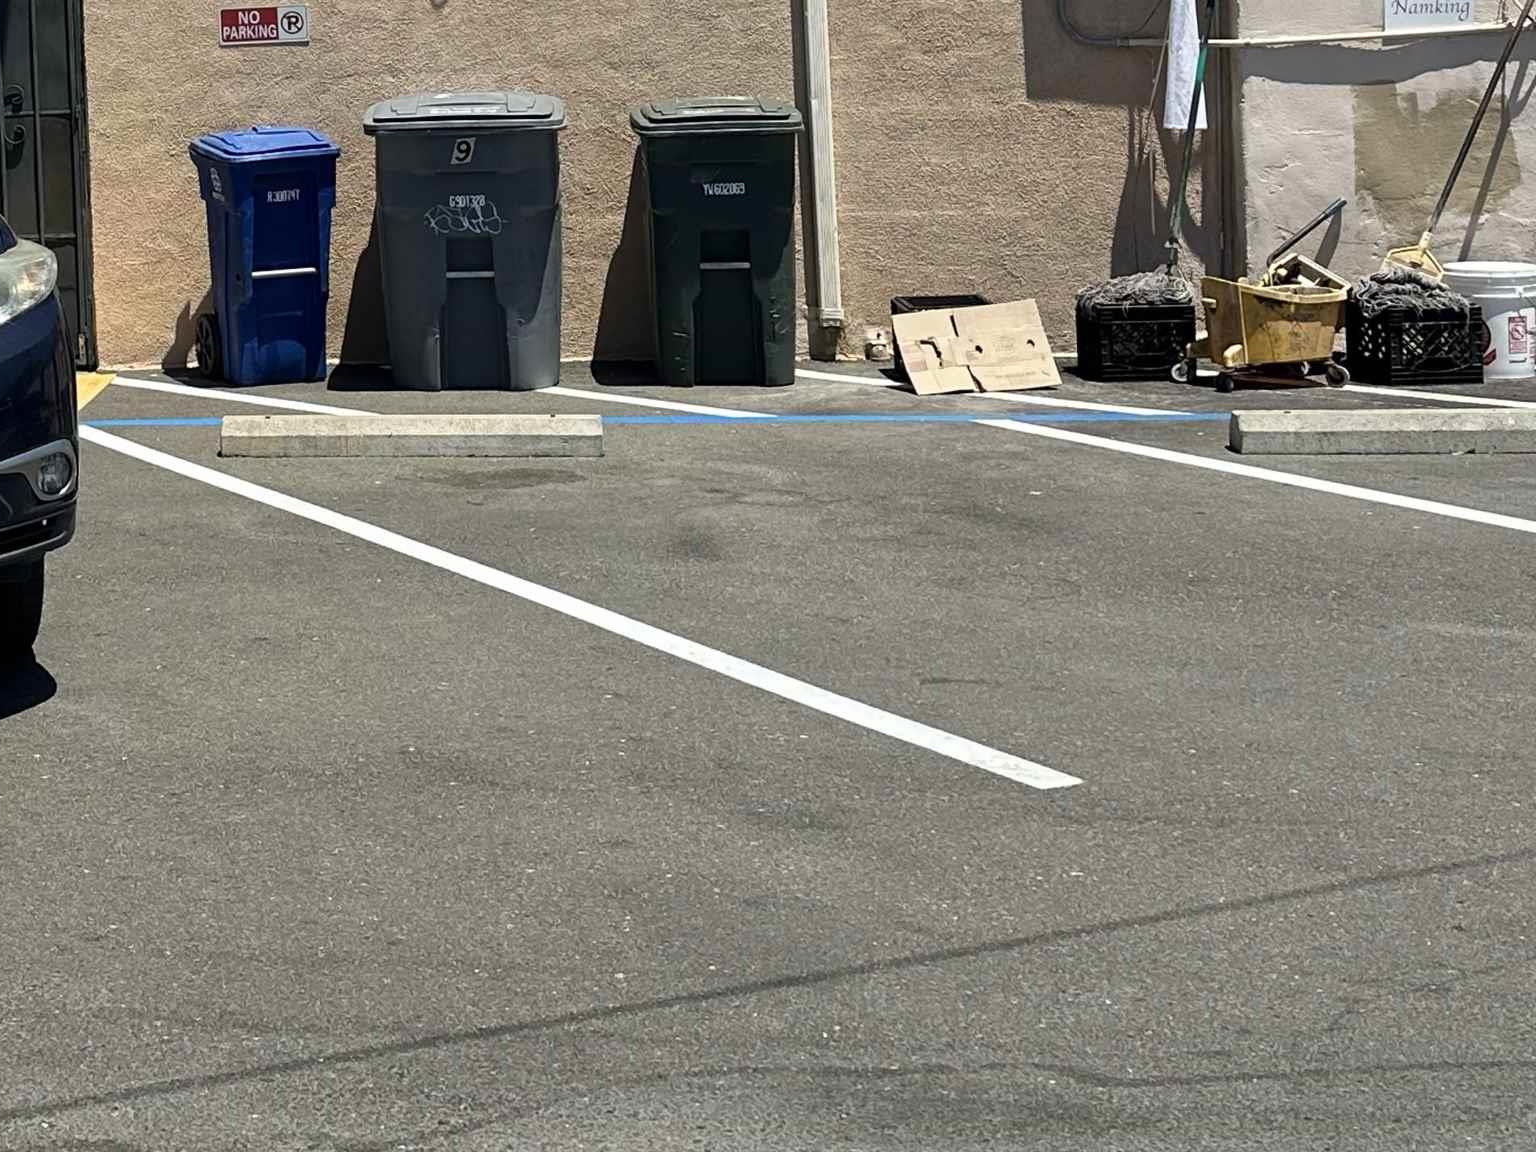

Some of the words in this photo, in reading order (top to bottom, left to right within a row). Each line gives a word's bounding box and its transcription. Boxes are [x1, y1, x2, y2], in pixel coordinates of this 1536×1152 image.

[238, 10, 261, 25] NO
[223, 24, 277, 40] PARKING
[455, 140, 472, 162] 9
